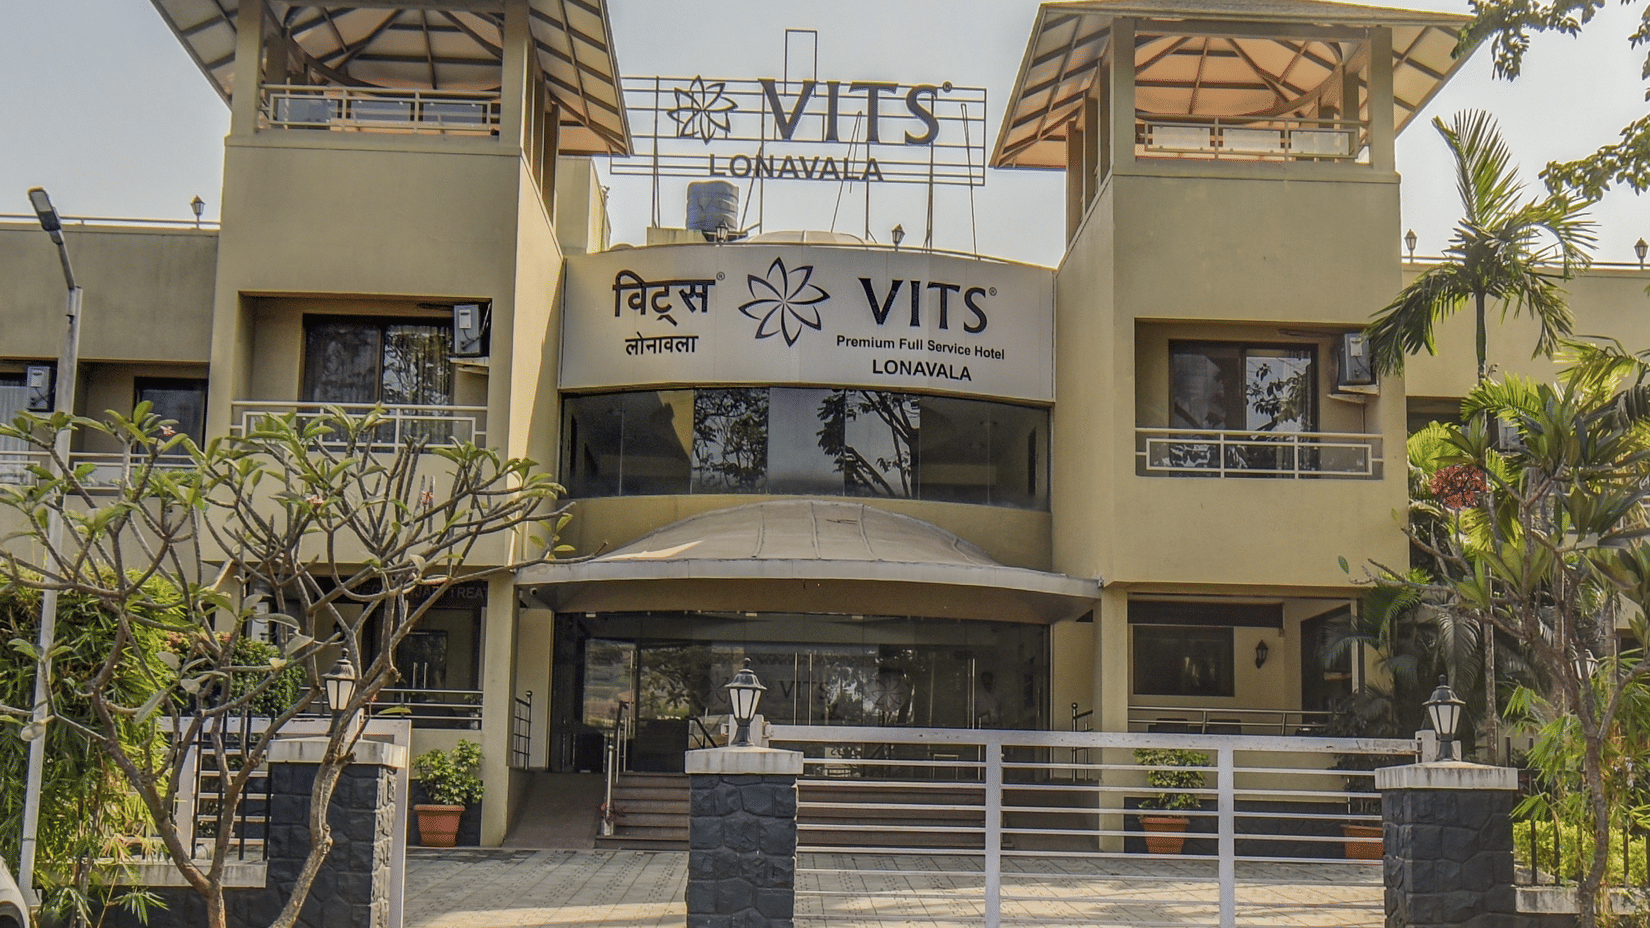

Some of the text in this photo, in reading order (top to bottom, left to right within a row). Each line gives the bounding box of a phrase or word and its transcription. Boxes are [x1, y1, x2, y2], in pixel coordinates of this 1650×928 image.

[710, 153, 884, 182] LONAVALA
[624, 331, 699, 356] लोनावला
[837, 335, 1005, 360] Premium Full Service Hotel
[872, 359, 972, 382] LONAVALA
